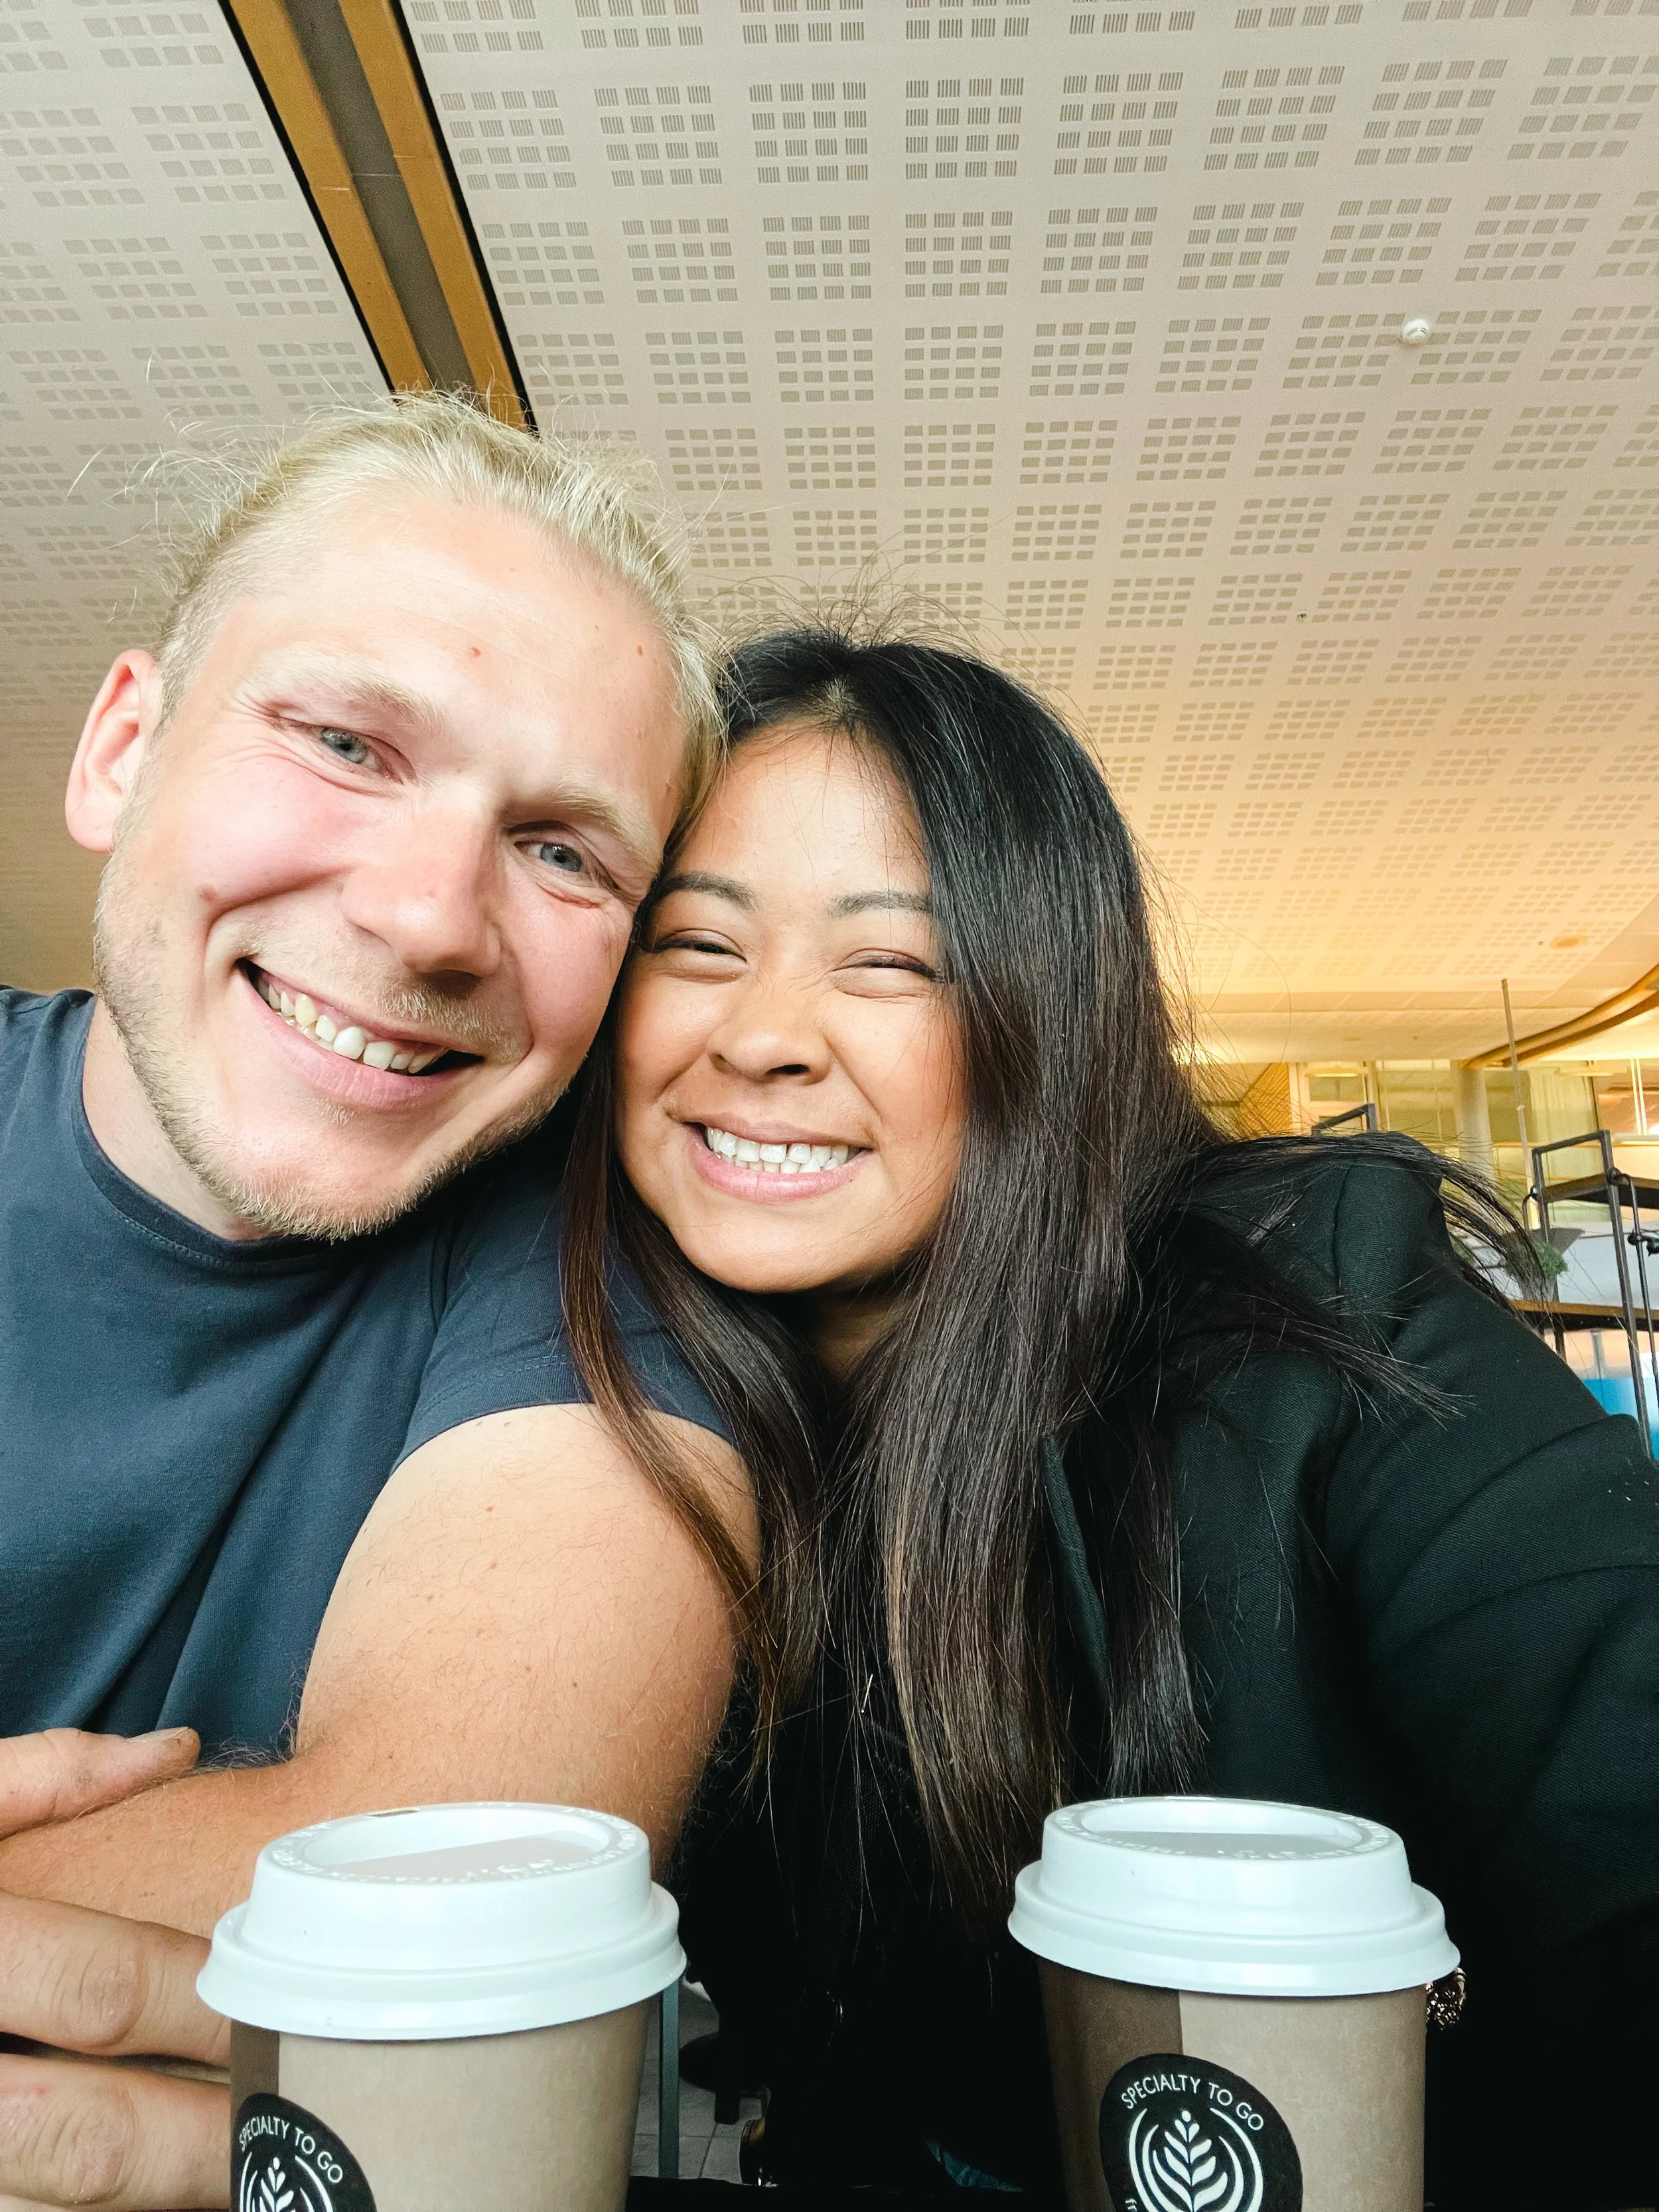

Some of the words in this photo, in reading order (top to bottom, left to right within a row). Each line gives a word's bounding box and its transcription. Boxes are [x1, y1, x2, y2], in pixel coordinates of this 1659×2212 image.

[1121, 2073, 1201, 2109] SPECIALTY
[1208, 2082, 1233, 2106] TO
[1236, 2102, 1264, 2130] GO
[239, 2115, 290, 2152] SPECIALTY
[295, 2127, 316, 2154] TO
[317, 2151, 343, 2183] GO
